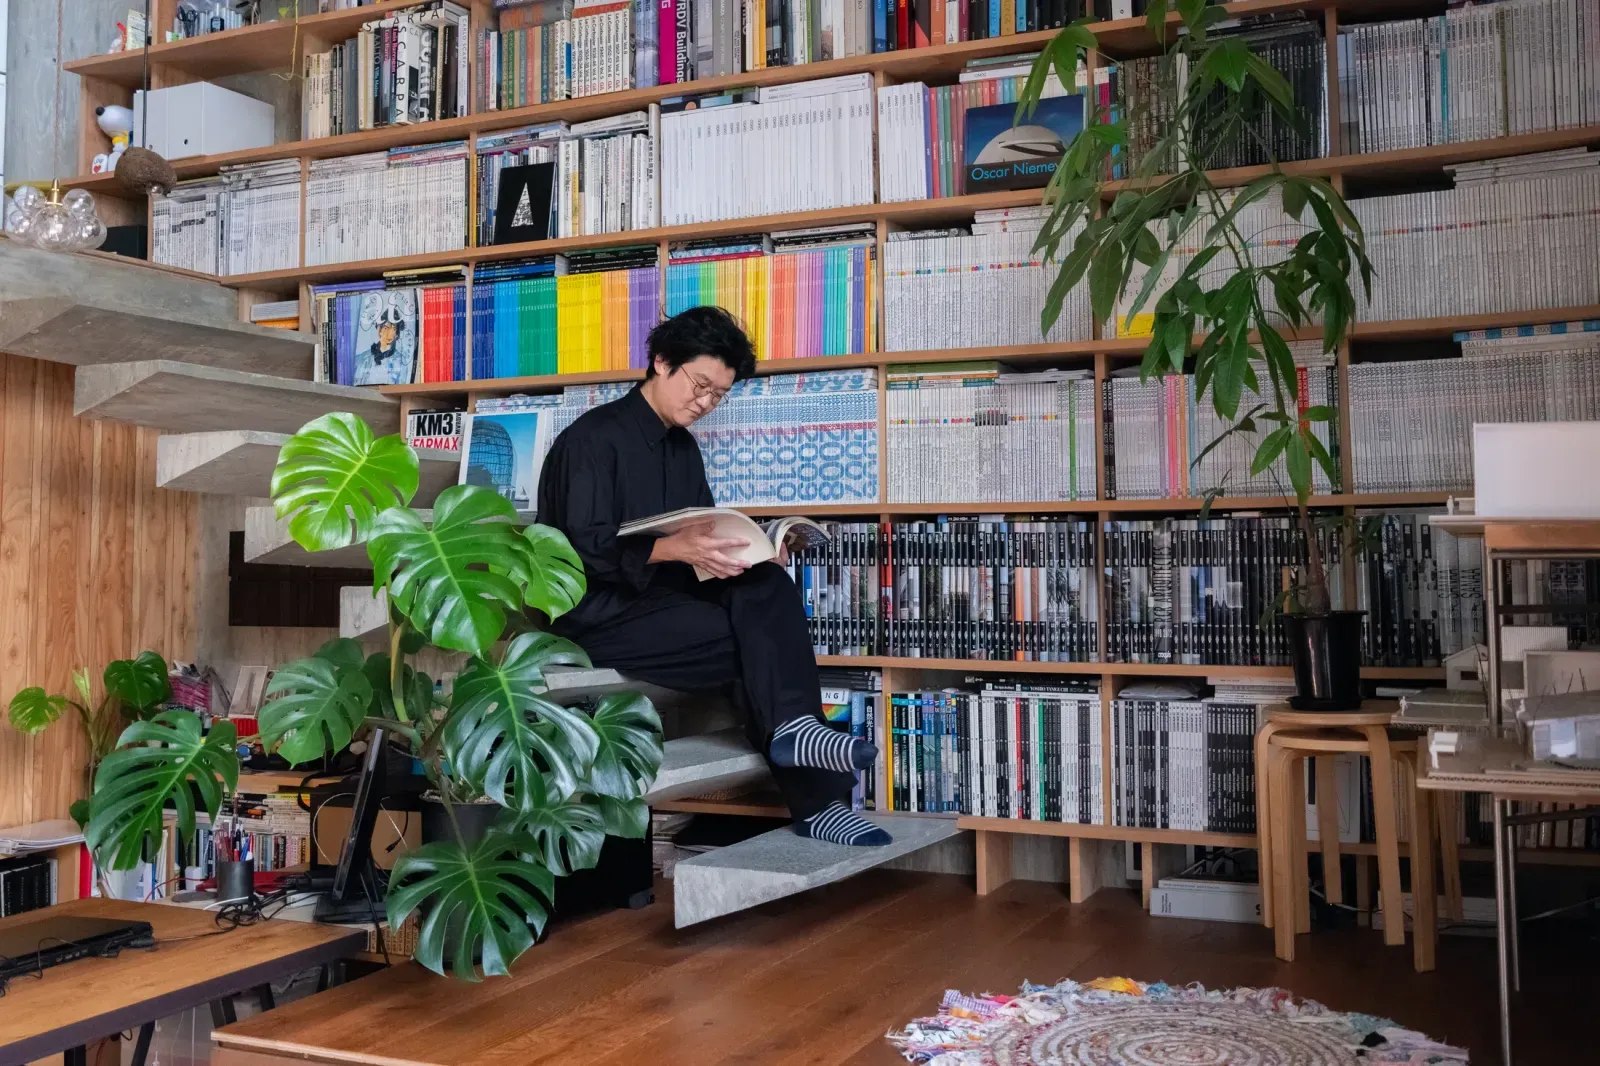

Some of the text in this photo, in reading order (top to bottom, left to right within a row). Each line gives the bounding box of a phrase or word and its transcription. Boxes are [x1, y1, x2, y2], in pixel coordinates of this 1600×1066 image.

[395, 26, 407, 118] SCARPA
[676, 31, 687, 84] Buildings
[971, 166, 1010, 181] Oscar
[413, 437, 459, 451] FARMAX
[416, 413, 454, 437] KM3
[776, 432, 797, 500] 2010
[797, 430, 818, 500] 2009
[818, 430, 845, 500] 2008
[1152, 546, 1173, 623] RCR ARQUITECTES
[1438, 569, 1459, 599] SANAA
[1460, 568, 1482, 599] SANAA
